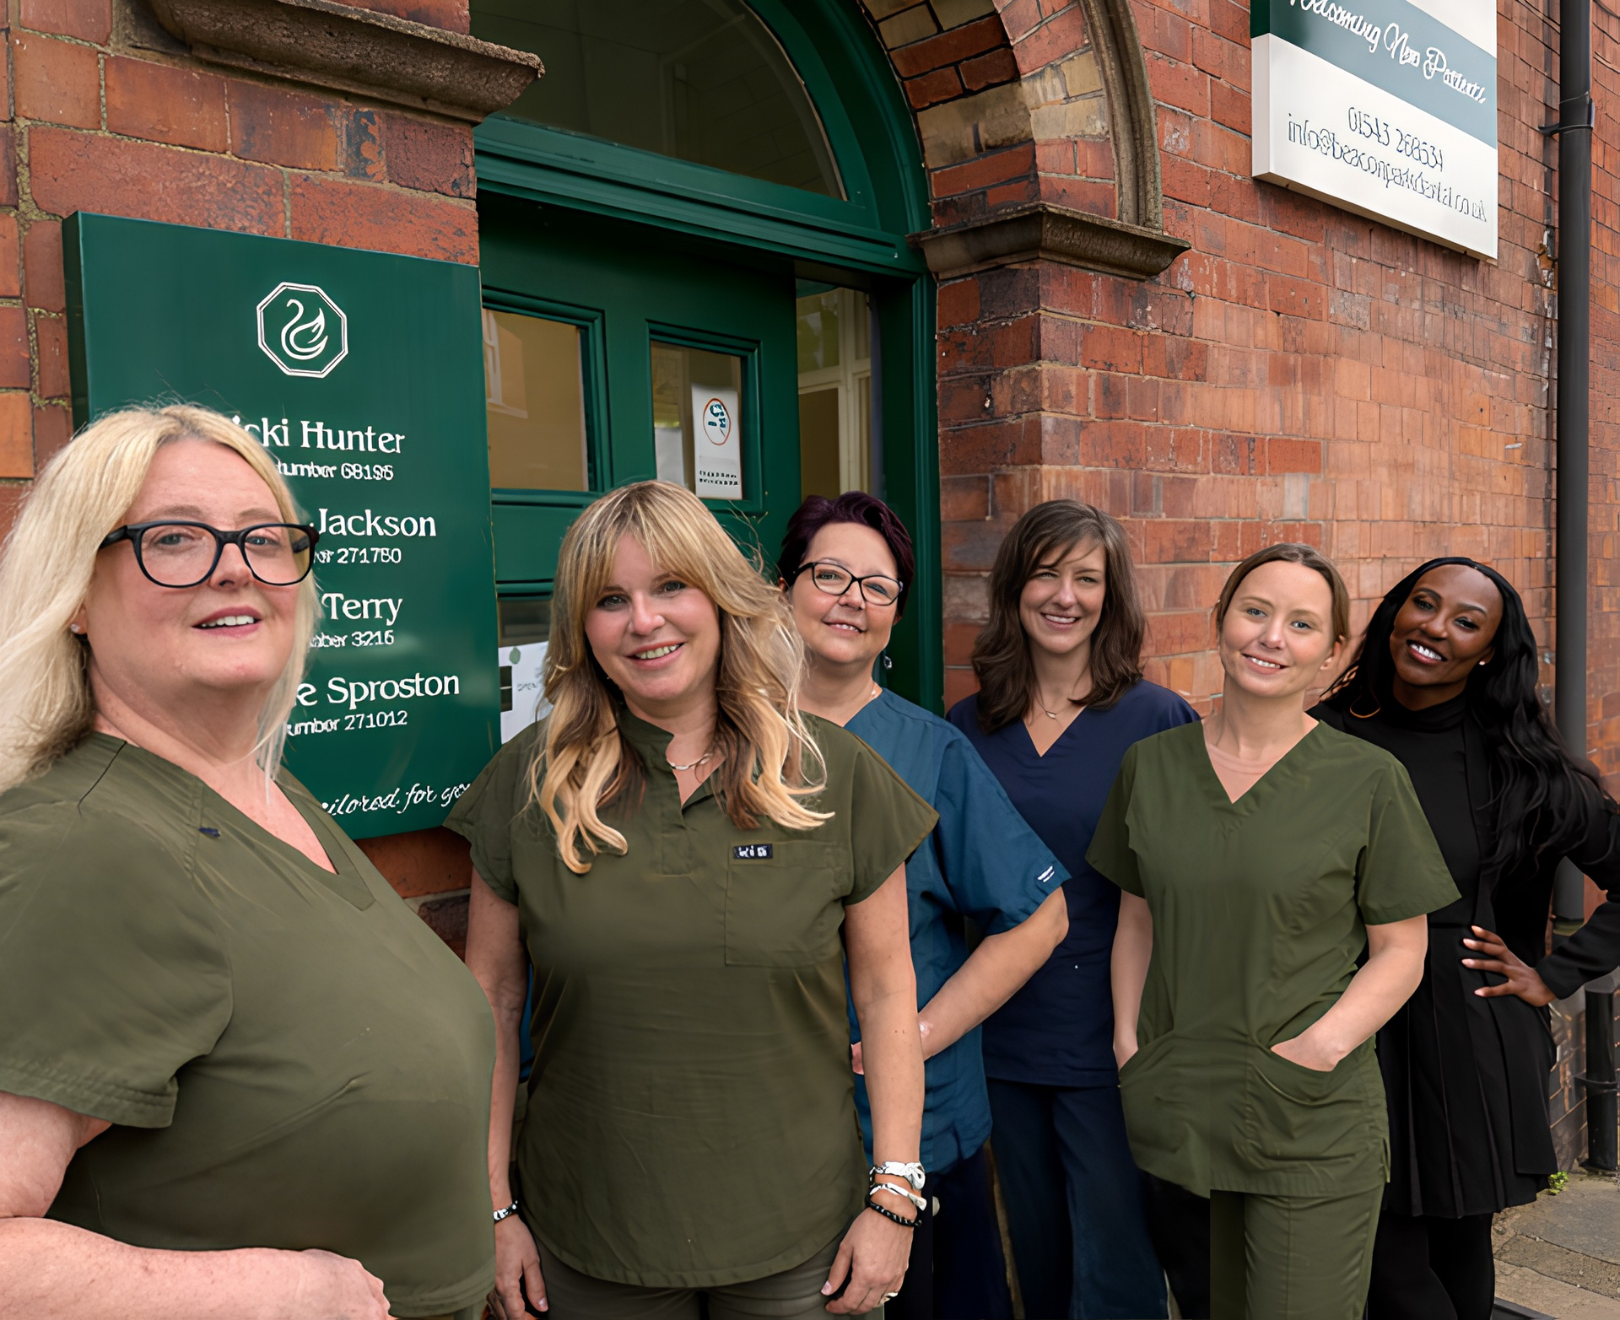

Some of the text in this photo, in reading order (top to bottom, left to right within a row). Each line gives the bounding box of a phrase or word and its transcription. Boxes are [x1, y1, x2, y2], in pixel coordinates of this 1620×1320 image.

[300, 420, 405, 454] Hunter
[318, 508, 437, 537] Jackson
[321, 592, 403, 626] Terry
[327, 672, 460, 710] Sproston
[344, 710, 408, 731] 271012
